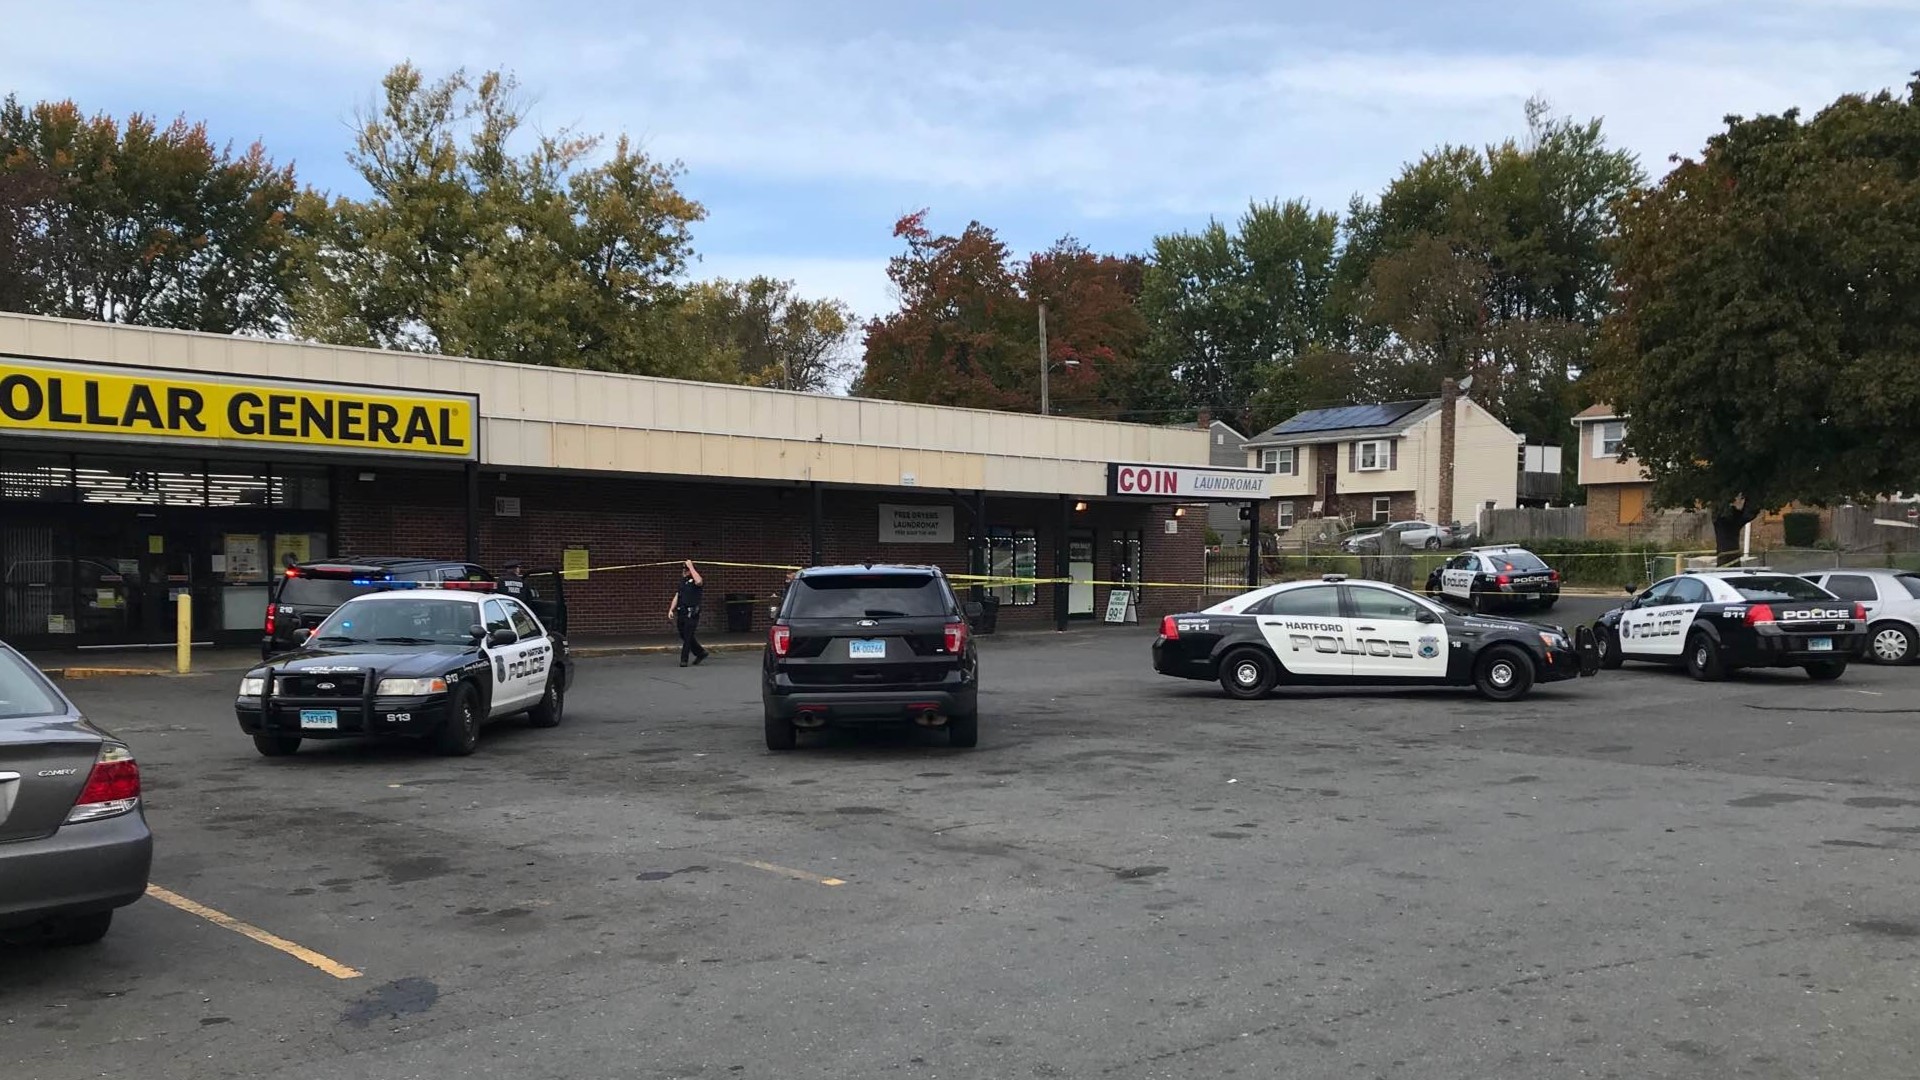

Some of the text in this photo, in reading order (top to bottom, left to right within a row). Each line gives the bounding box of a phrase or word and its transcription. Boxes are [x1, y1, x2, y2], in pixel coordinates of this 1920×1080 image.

[0, 374, 464, 447] OLLAR GENERAL
[1120, 468, 1263, 493] COIN LAUNDROMAT
[893, 521, 939, 529] LAUNDROMAT
[1447, 577, 1468, 588] POLICE
[1513, 575, 1549, 583] POLICE
[1658, 609, 1685, 617] HARTFORD
[1783, 609, 1849, 619] POLICE
[1286, 622, 1343, 632] HARTFORD
[1632, 619, 1681, 639] POLICE
[1289, 634, 1413, 659] POLICE
[508, 656, 545, 681] POLICE
[445, 673, 459, 684] S13
[386, 713, 411, 722] S13
[38, 768, 77, 777] CAMRY
